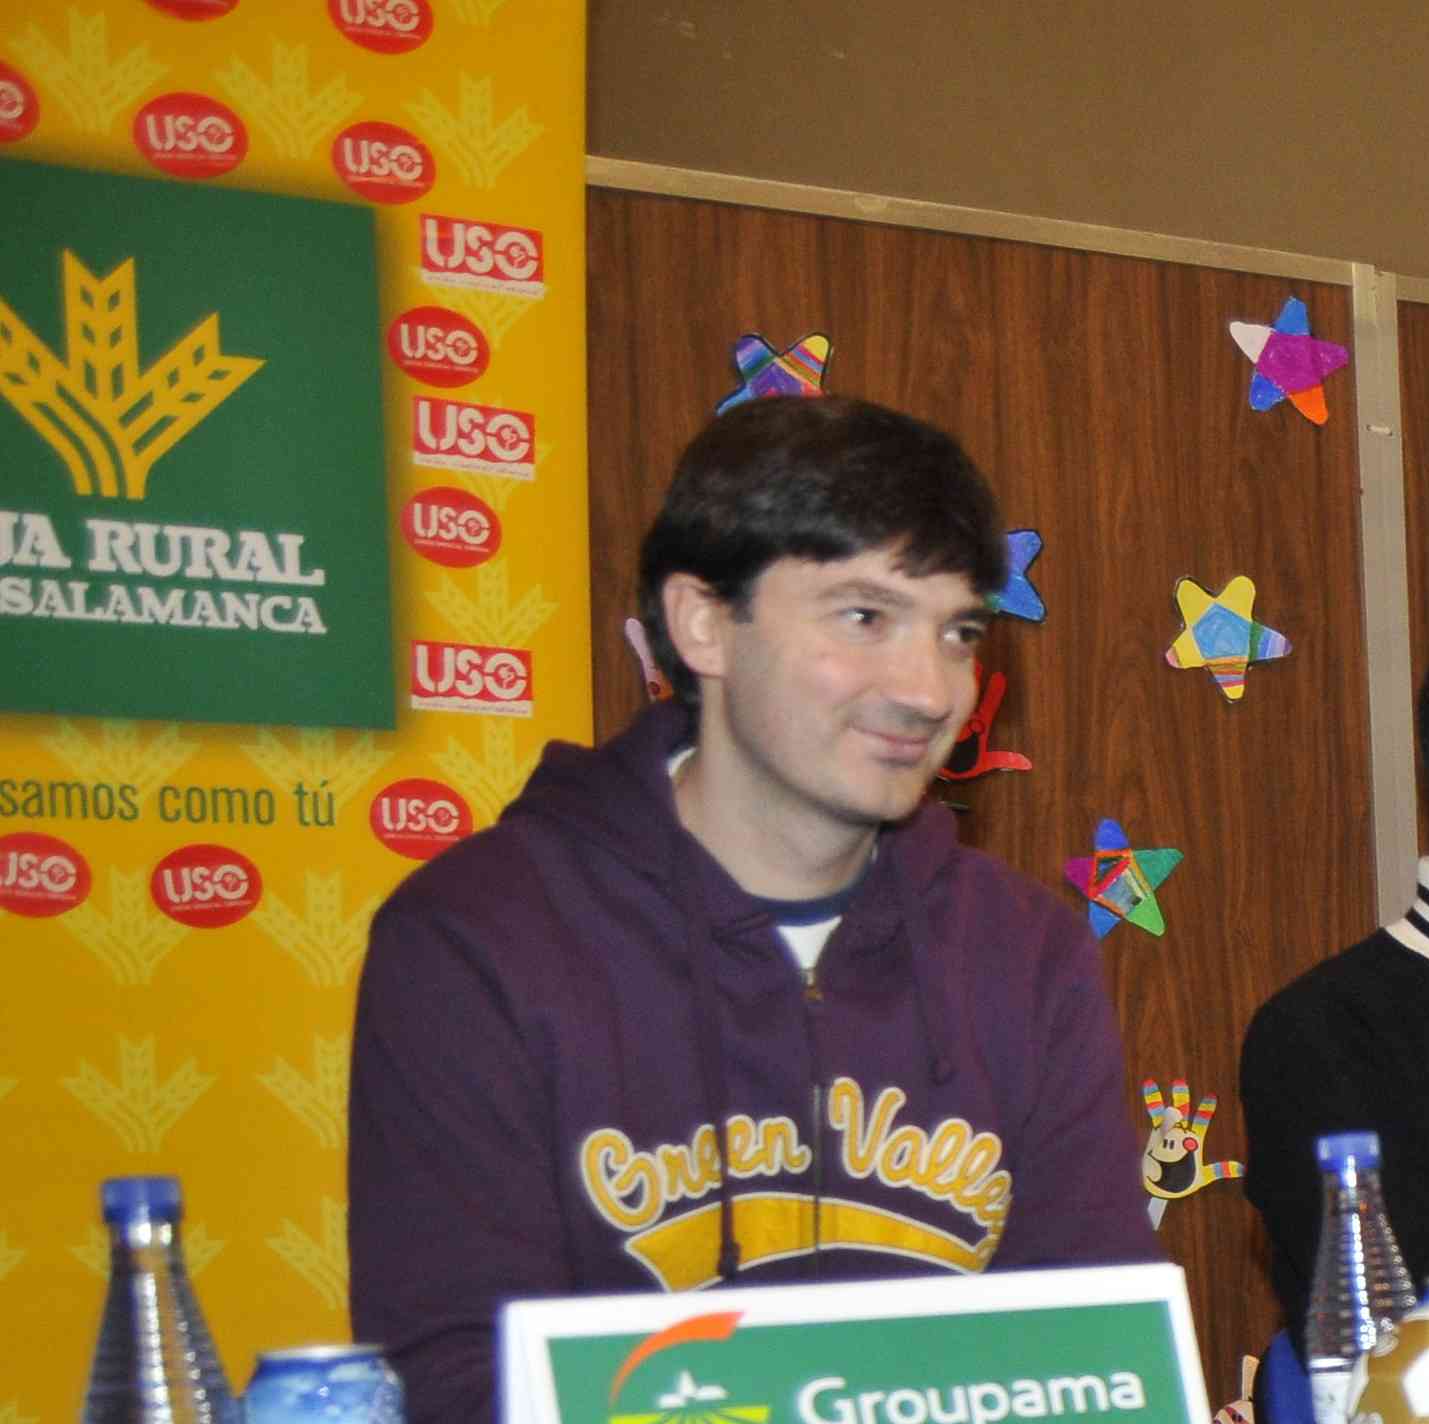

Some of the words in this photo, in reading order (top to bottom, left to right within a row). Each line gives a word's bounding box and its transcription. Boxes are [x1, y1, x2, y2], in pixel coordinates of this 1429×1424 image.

[146, 114, 235, 153] USO
[343, 138, 424, 181] USO
[425, 218, 540, 281] USO
[400, 323, 479, 366] USO
[418, 400, 530, 462] USO
[413, 502, 491, 545] USO
[0, 510, 72, 569] JA
[86, 518, 326, 587] RURAL
[0, 575, 328, 635] SALAMANCA
[416, 643, 528, 700] USO
[159, 785, 276, 825] como
[293, 780, 337, 828] tú
[381, 797, 460, 834] USO
[163, 864, 249, 904] USO
[581, 1115, 812, 1232] Green
